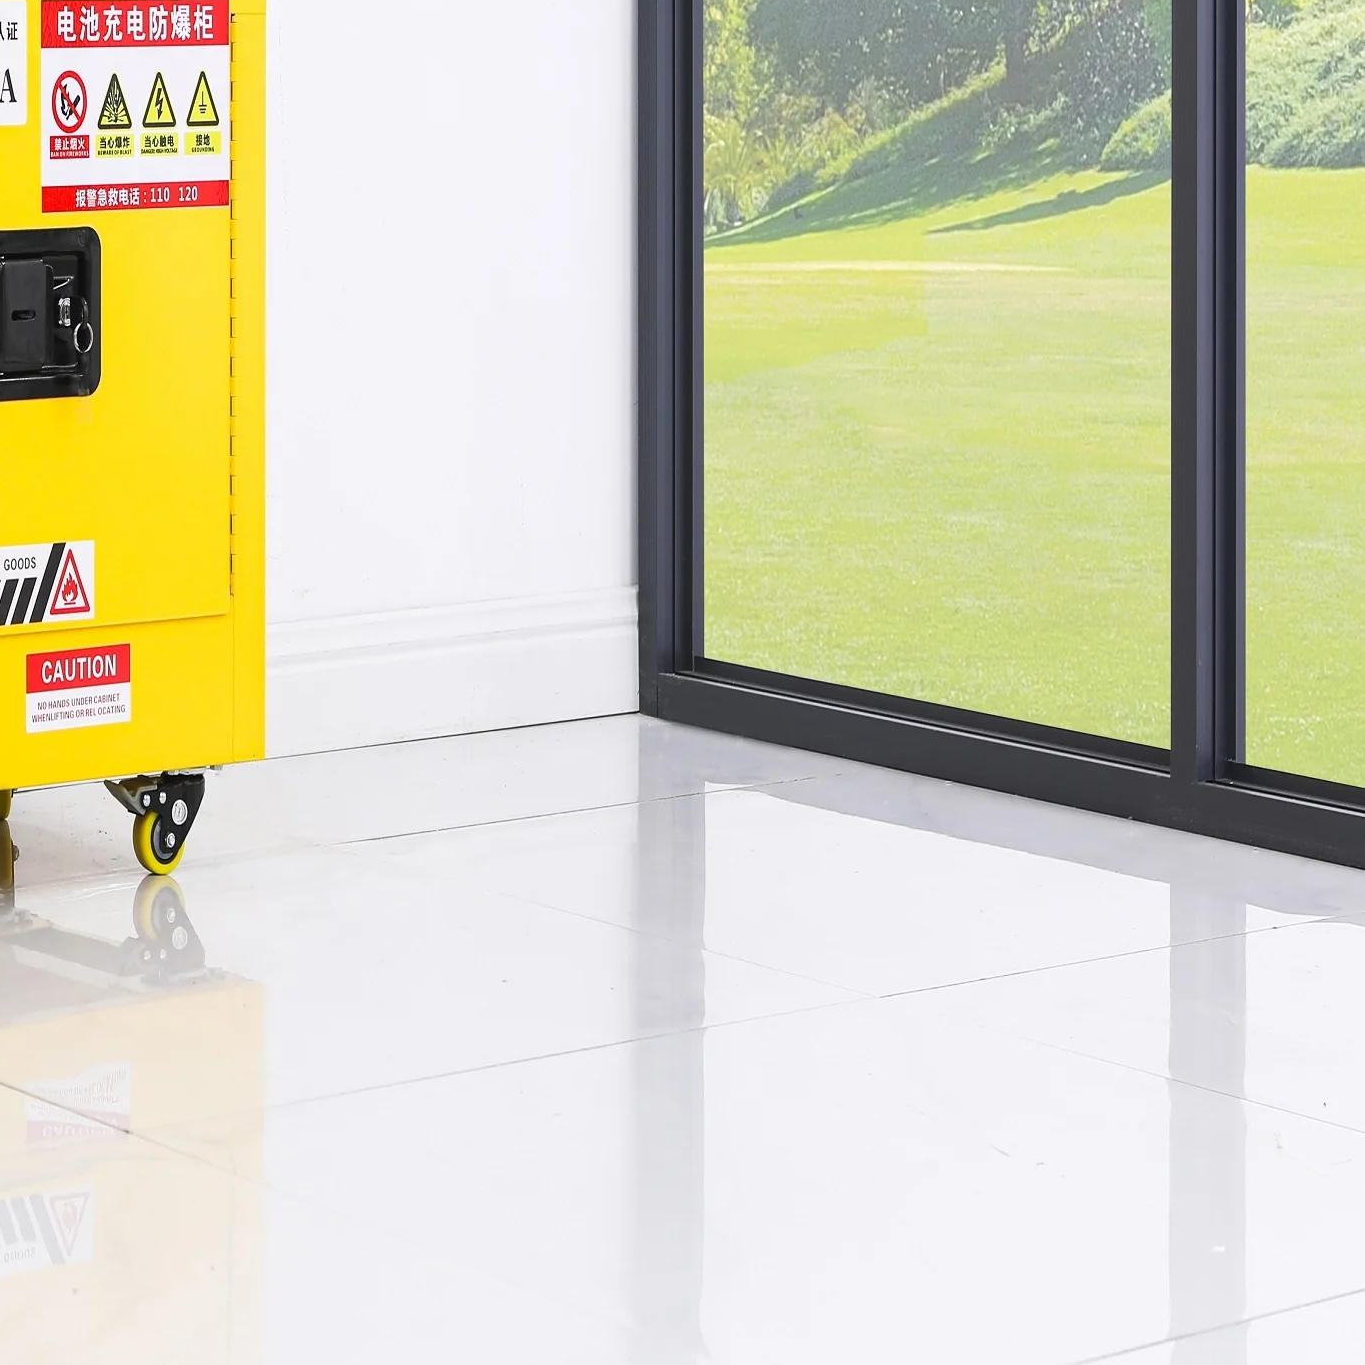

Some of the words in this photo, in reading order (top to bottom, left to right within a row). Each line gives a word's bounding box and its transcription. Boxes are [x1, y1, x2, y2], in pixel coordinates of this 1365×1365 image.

[57, 4, 214, 42] 电池充电防爆柜
[54, 137, 86, 151] 禁止烟火
[99, 136, 130, 149] 当心爆炸
[144, 135, 175, 147] 当心触电
[196, 133, 211, 146] 接地
[178, 186, 198, 202] 120
[3, 556, 37, 571] GOODS
[41, 654, 117, 684] CAUTION
[37, 701, 47, 711] NO
[48, 698, 70, 709] HANDS
[71, 696, 93, 707] UNDER
[93, 693, 120, 704] CABINET
[75, 709, 85, 719] OR
